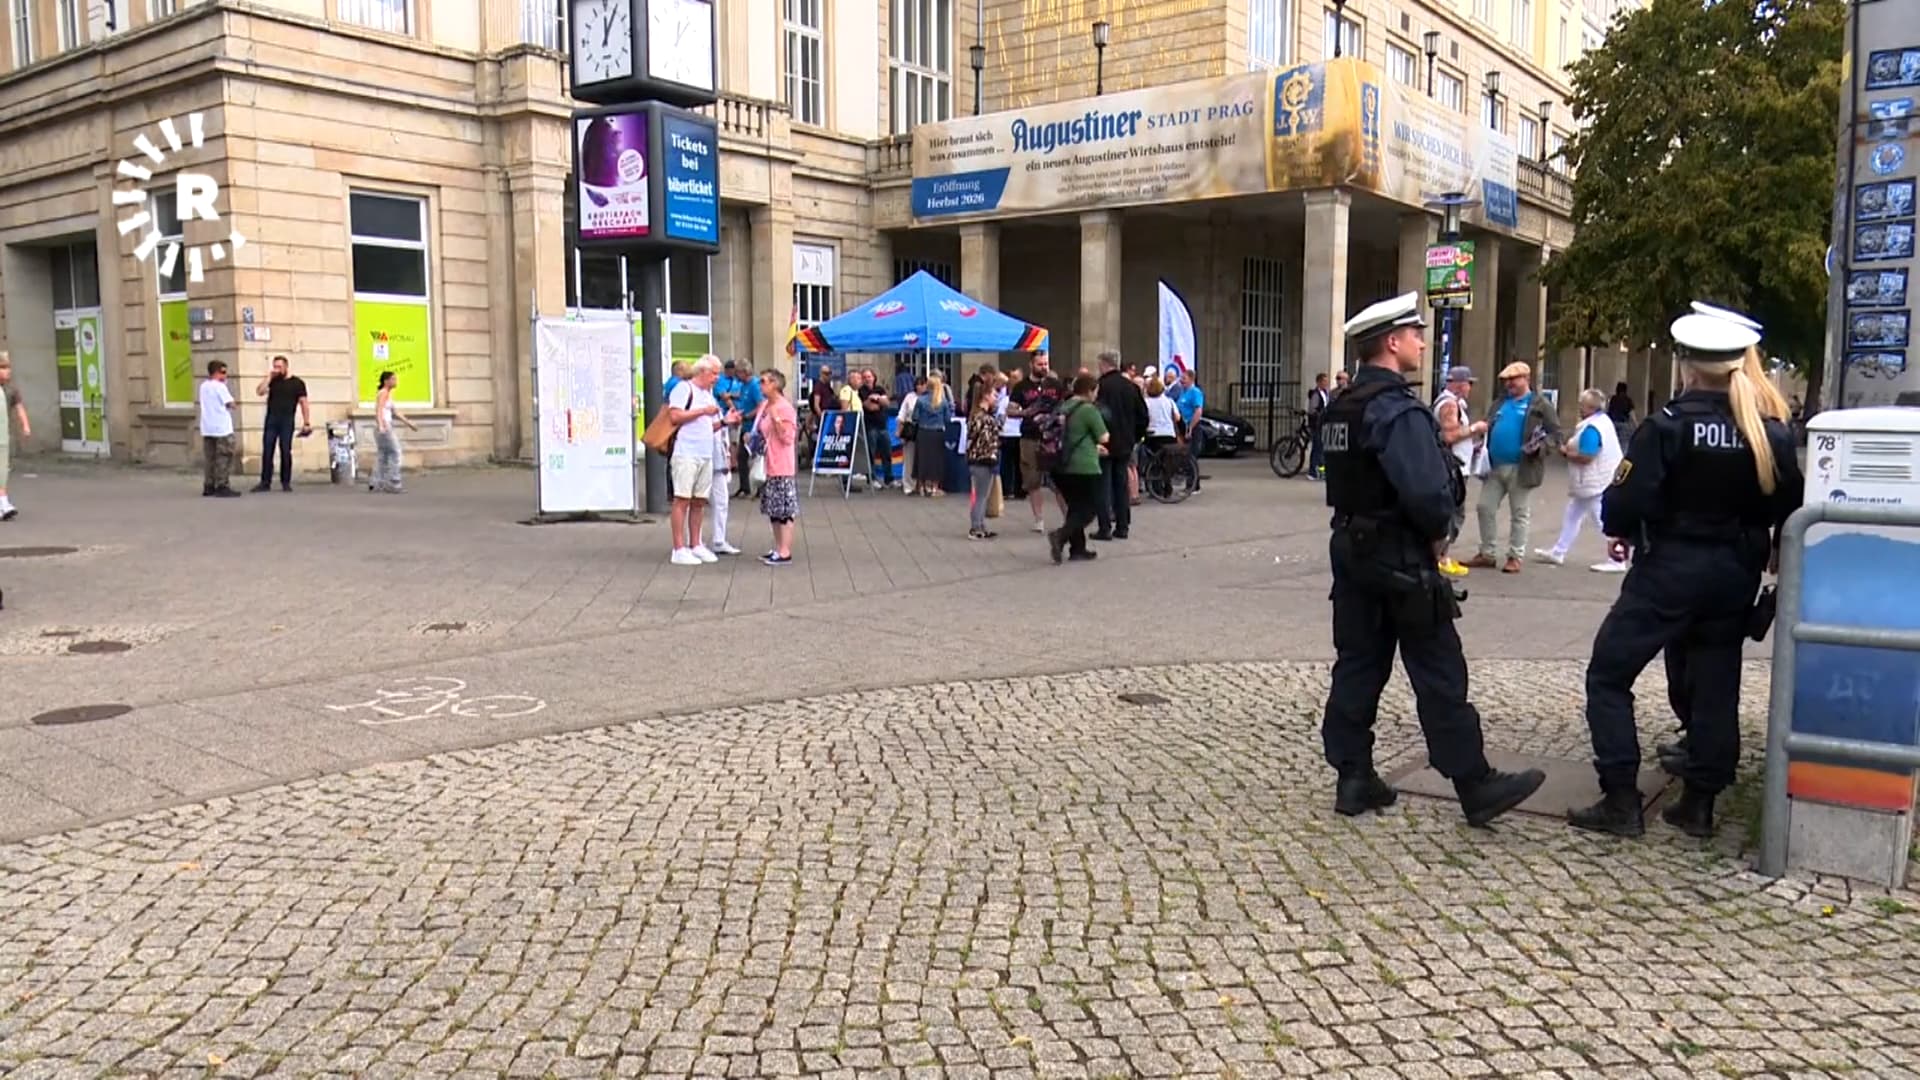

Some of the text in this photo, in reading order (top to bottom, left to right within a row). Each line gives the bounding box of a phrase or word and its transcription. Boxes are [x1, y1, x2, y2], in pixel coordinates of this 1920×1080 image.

[1011, 100, 1254, 153] Augustiner STADT PRAG
[671, 132, 708, 156] Tickets
[975, 130, 993, 142] sich
[1025, 133, 1236, 172] ein neues Augustiner Wirtshaus entsteht!
[681, 153, 699, 171] bei
[933, 180, 980, 194] Eröffnung
[927, 193, 984, 208] Herbst 2026
[1817, 435, 1836, 451] 78
